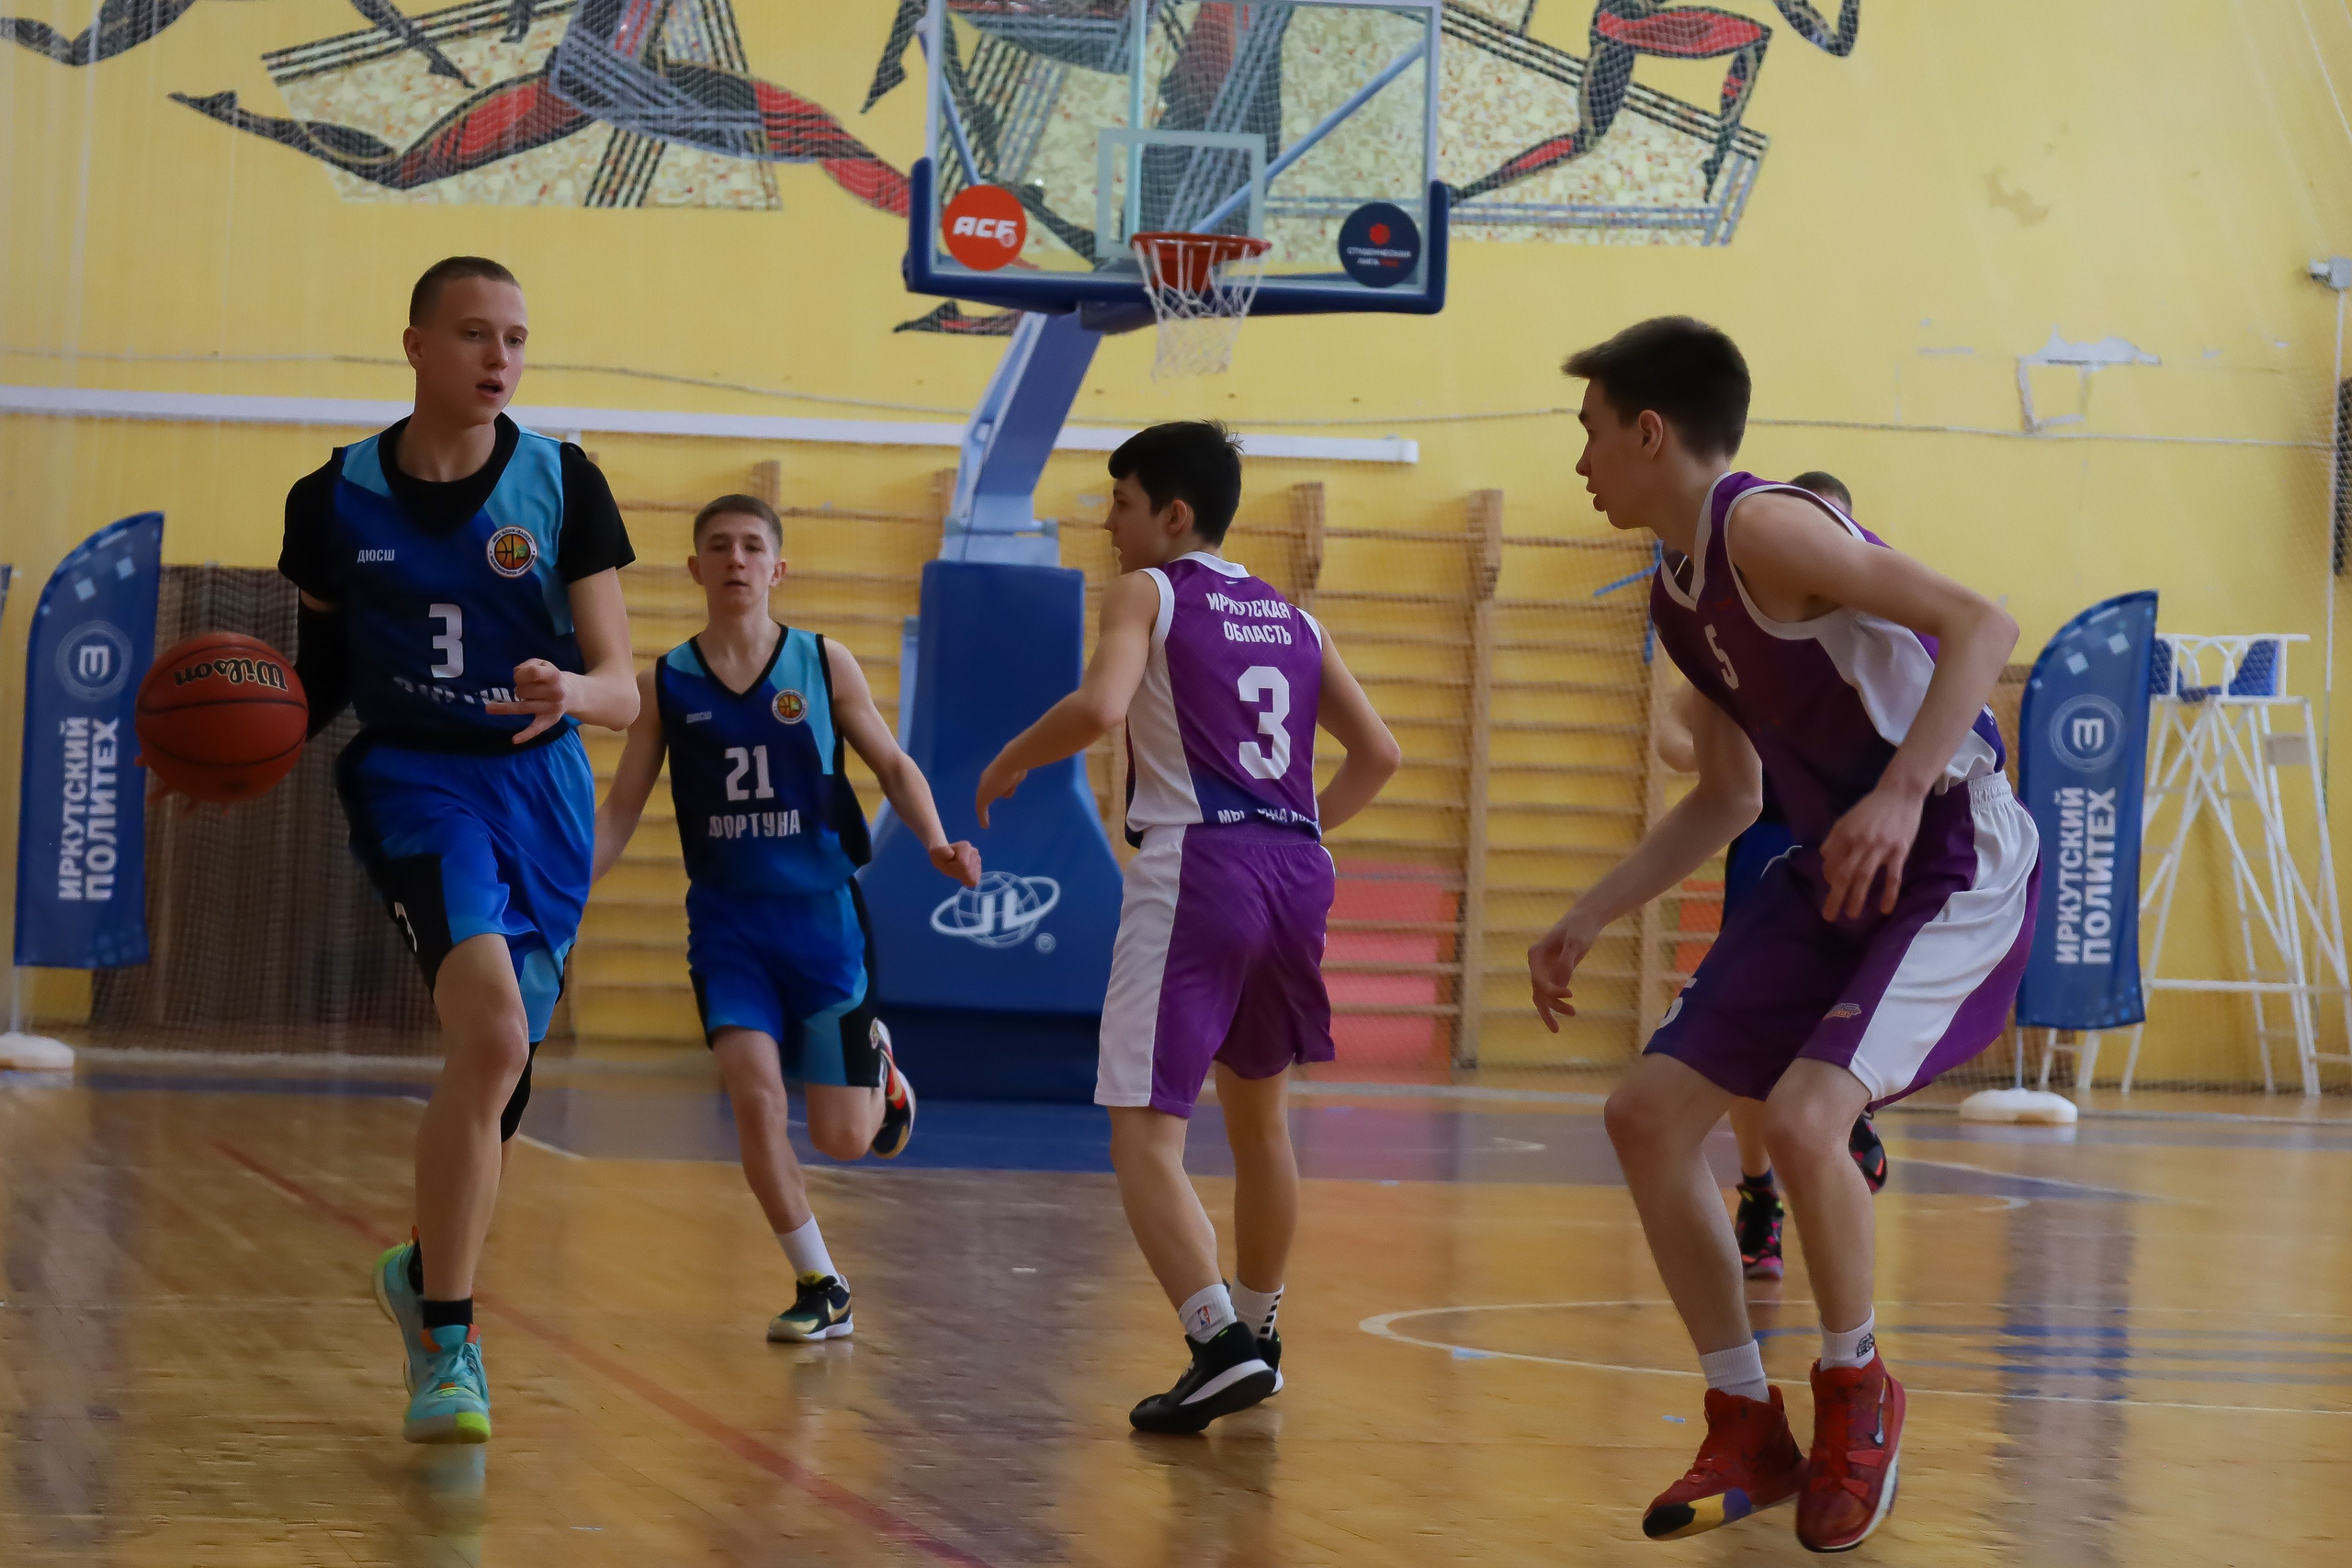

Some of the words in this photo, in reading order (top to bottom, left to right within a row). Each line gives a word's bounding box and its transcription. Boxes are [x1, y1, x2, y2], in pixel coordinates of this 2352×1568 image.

[356, 548, 395, 563] ДЮСШ
[428, 603, 464, 678] 3
[1223, 620, 1292, 645] ОБЛАСТЬ
[1704, 624, 1739, 690] 5
[173, 658, 288, 693] Wilson
[1237, 665, 1291, 780] 3
[58, 716, 90, 901] ИРКУТСКИЙ
[85, 716, 120, 902] ПОЛИТЕХ
[724, 744, 775, 801] 21
[2054, 786, 2086, 964] ИРКУТСКИЙ
[2082, 787, 2116, 964] ПОЛИТЕХ
